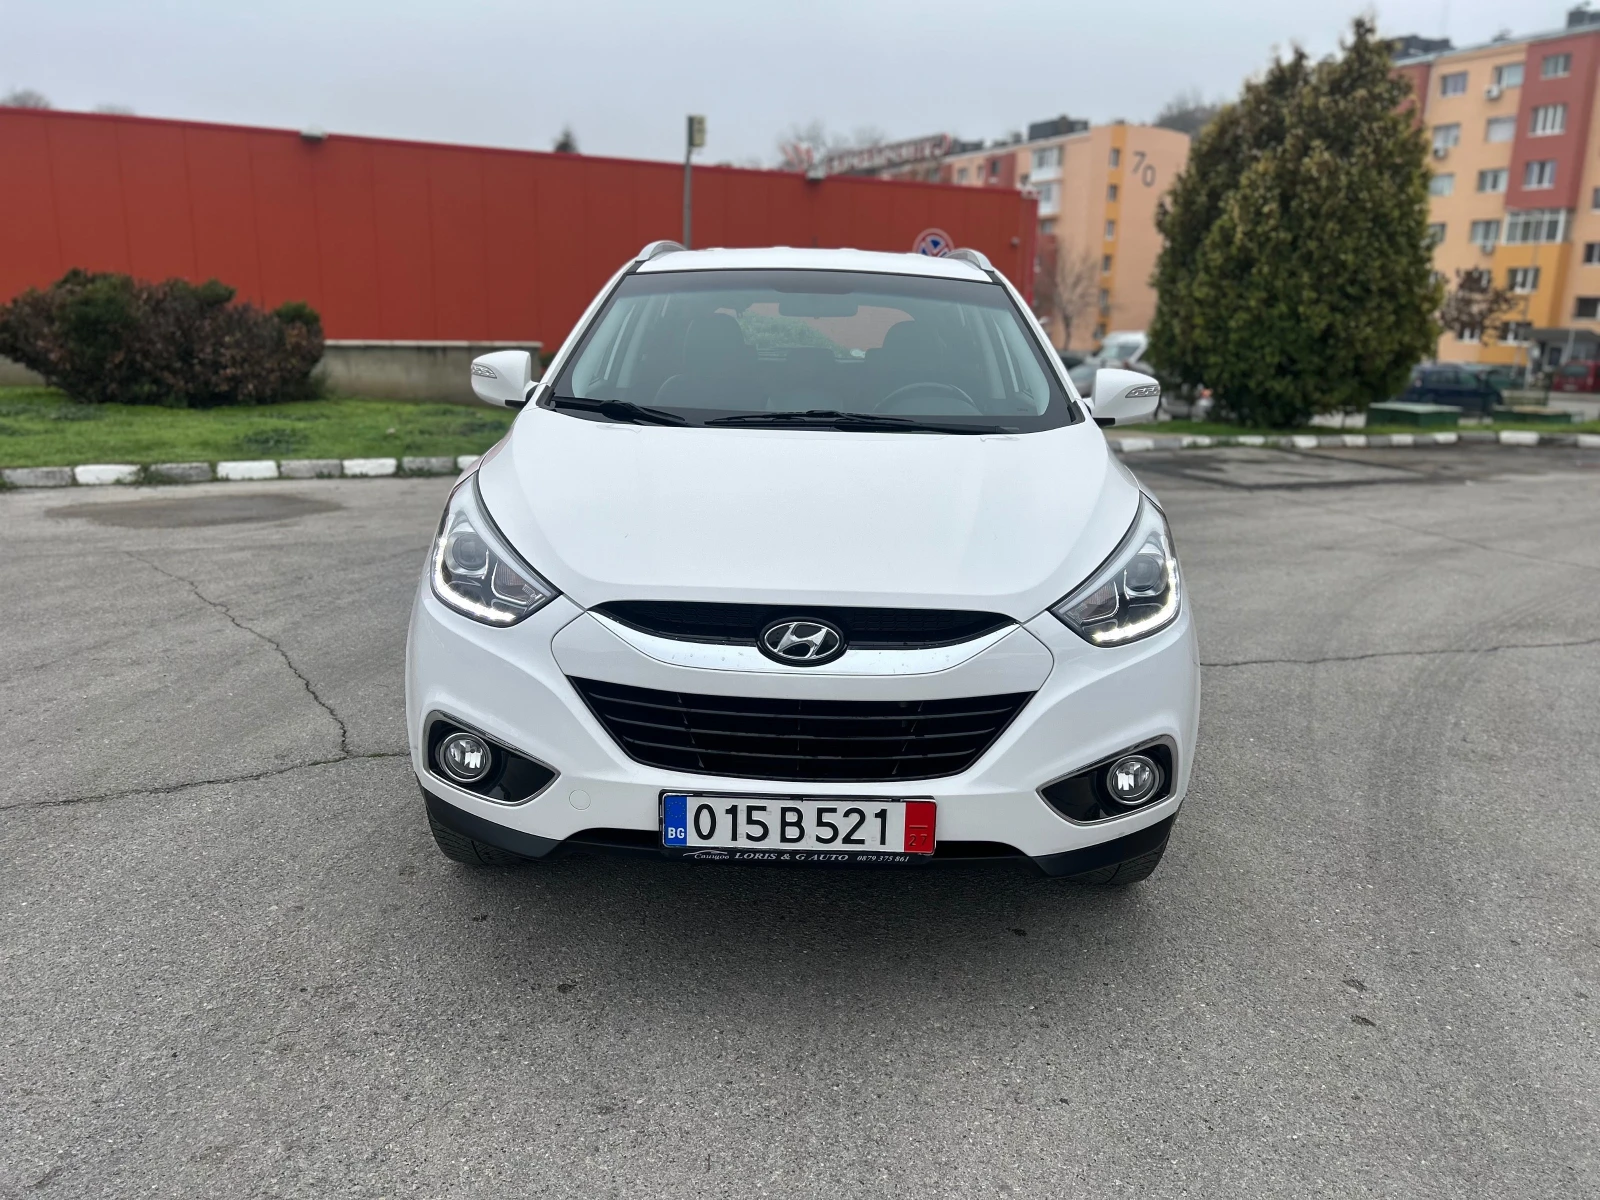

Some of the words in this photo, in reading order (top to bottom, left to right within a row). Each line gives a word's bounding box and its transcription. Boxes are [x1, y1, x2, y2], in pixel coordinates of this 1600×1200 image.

[1131, 150, 1157, 188] 70
[667, 827, 685, 839] BG
[908, 833, 928, 847] 27
[734, 852, 778, 860] LORIS
[795, 853, 807, 861] G
[808, 853, 849, 861] AUTO
